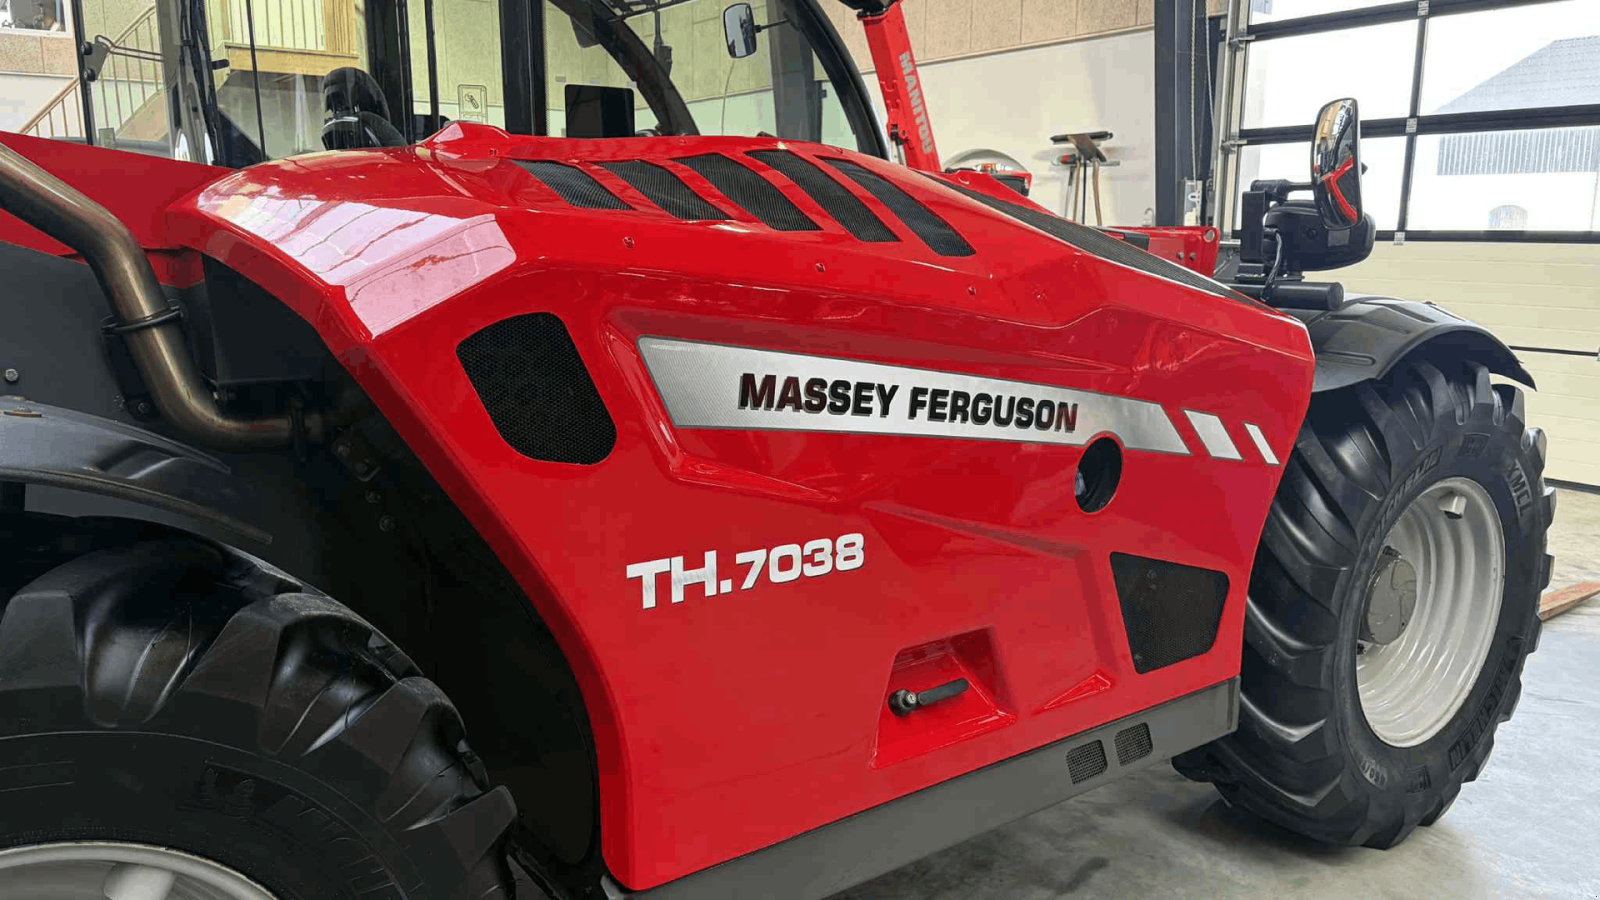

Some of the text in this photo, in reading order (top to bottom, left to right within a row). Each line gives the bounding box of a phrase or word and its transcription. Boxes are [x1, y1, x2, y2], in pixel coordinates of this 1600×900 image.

[899, 51, 932, 154] MANITOU
[738, 373, 1079, 433] MASSEY FERGUSON
[1503, 459, 1533, 517] XMCL
[626, 532, 865, 610] TH.7038
